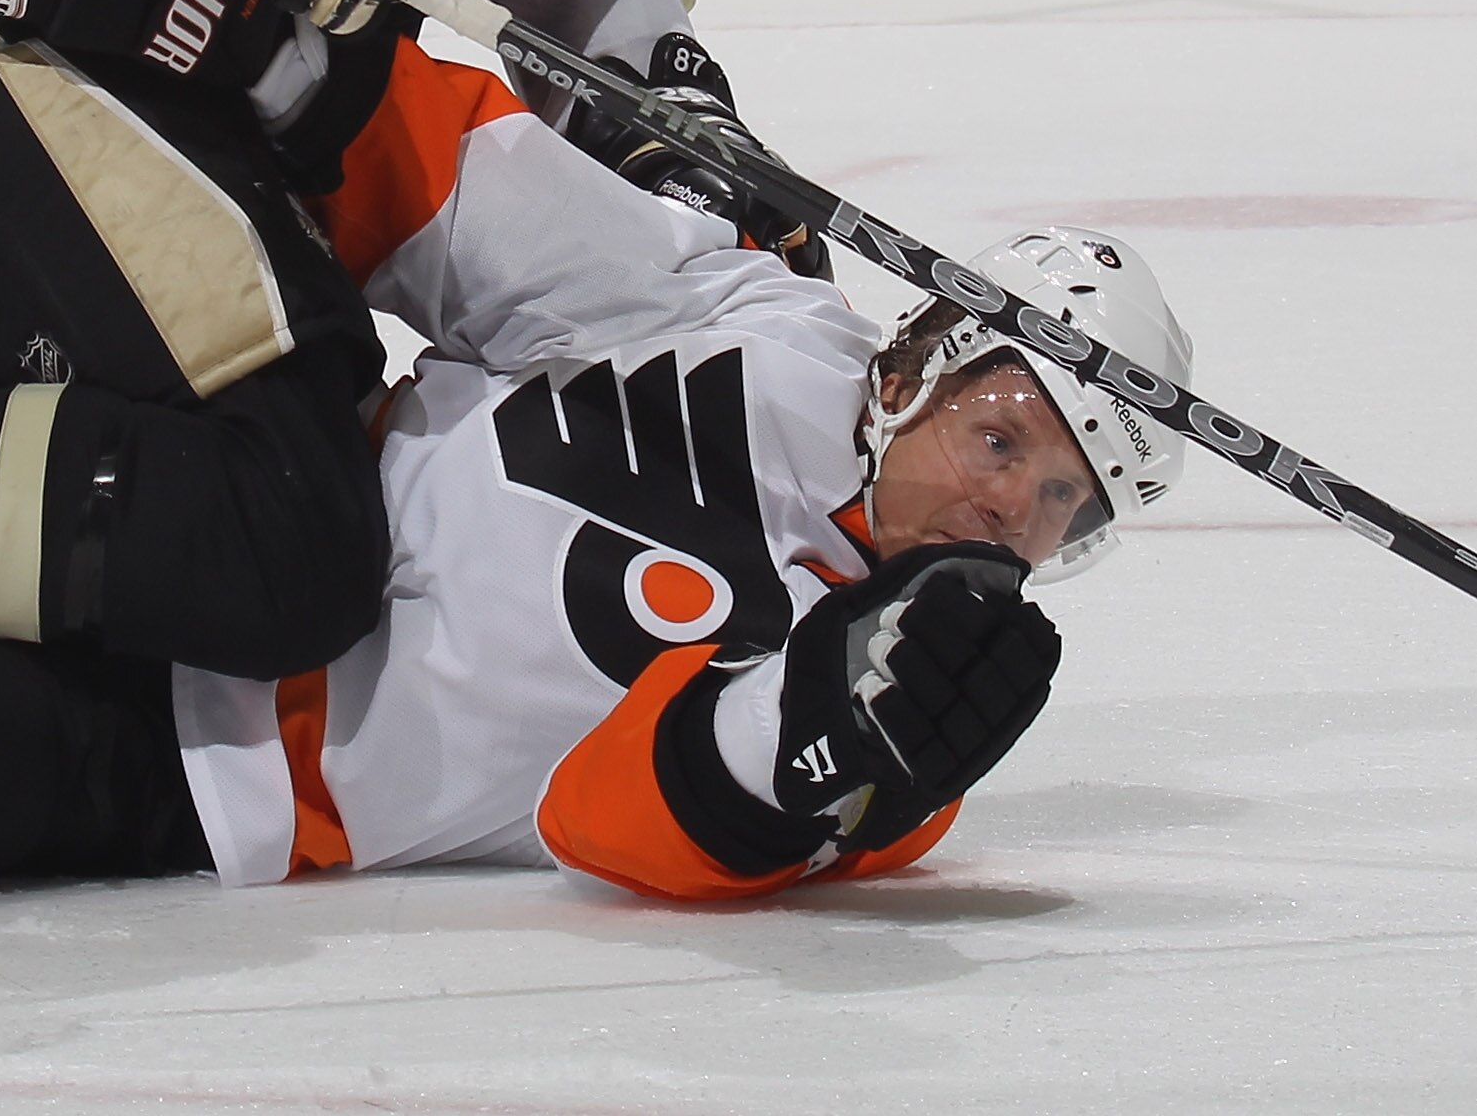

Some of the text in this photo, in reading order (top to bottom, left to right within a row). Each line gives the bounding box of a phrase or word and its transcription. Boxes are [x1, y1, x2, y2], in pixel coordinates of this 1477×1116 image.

[497, 42, 602, 107] ebok
[674, 47, 707, 76] 87
[659, 179, 712, 212] Reebok
[828, 198, 1352, 521] Reebok
[1110, 397, 1152, 463] Reebok
